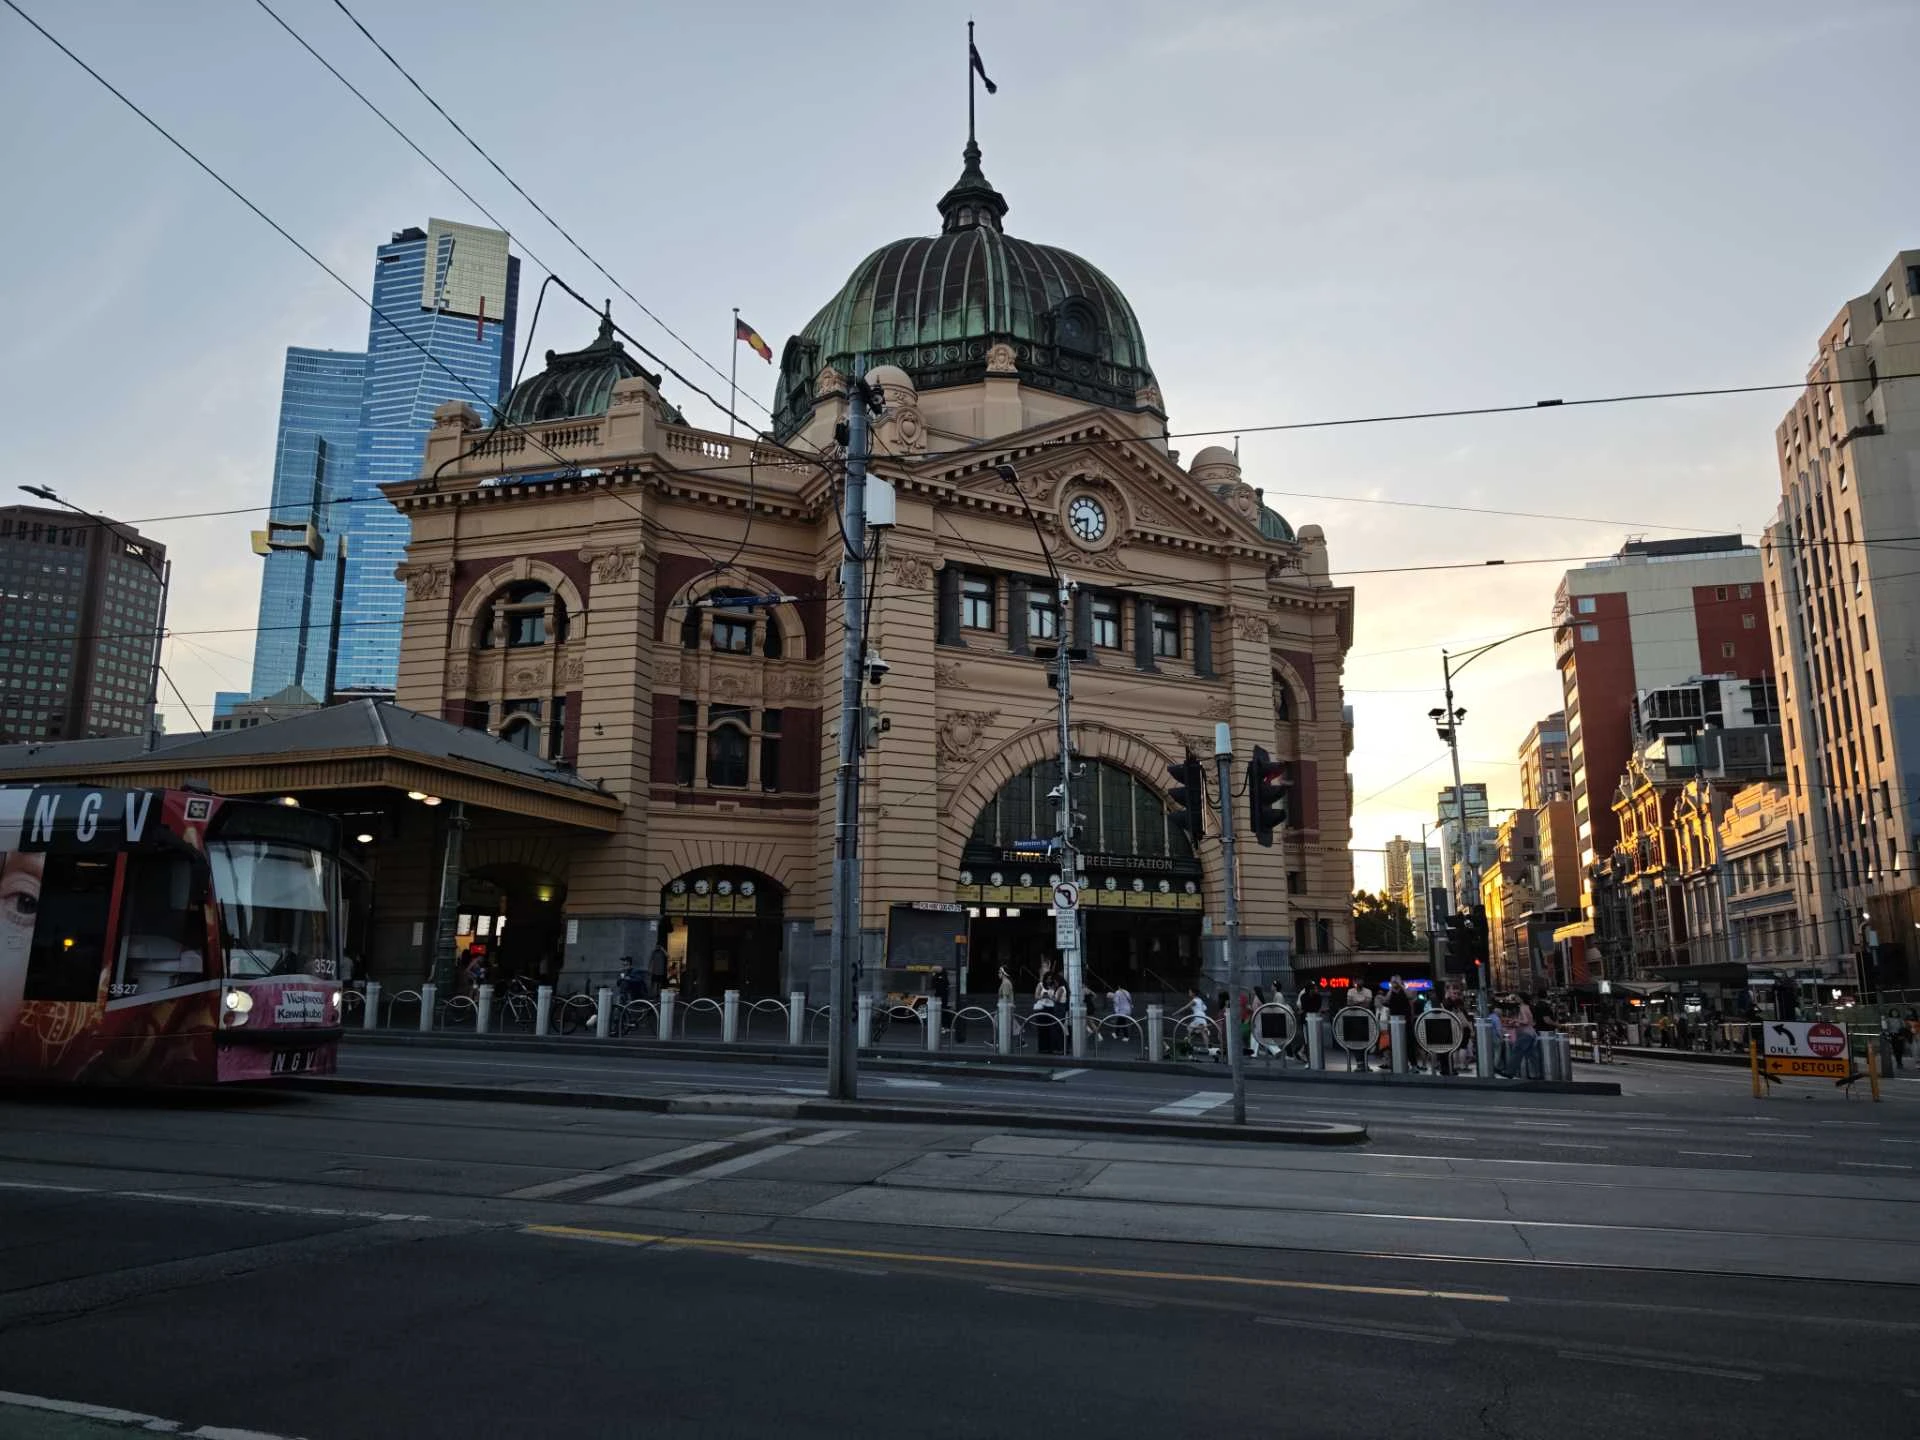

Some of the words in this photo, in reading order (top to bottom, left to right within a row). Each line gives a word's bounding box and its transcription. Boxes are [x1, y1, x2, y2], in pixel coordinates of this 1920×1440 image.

[30, 792, 152, 843] NGV
[1125, 857, 1173, 871] STATION
[109, 984, 138, 995] 3527
[1819, 1028, 1832, 1036] NO
[1770, 1046, 1799, 1055] ONLY
[1812, 1044, 1842, 1053] ENTRY
[1792, 1062, 1845, 1073] DETOUR
